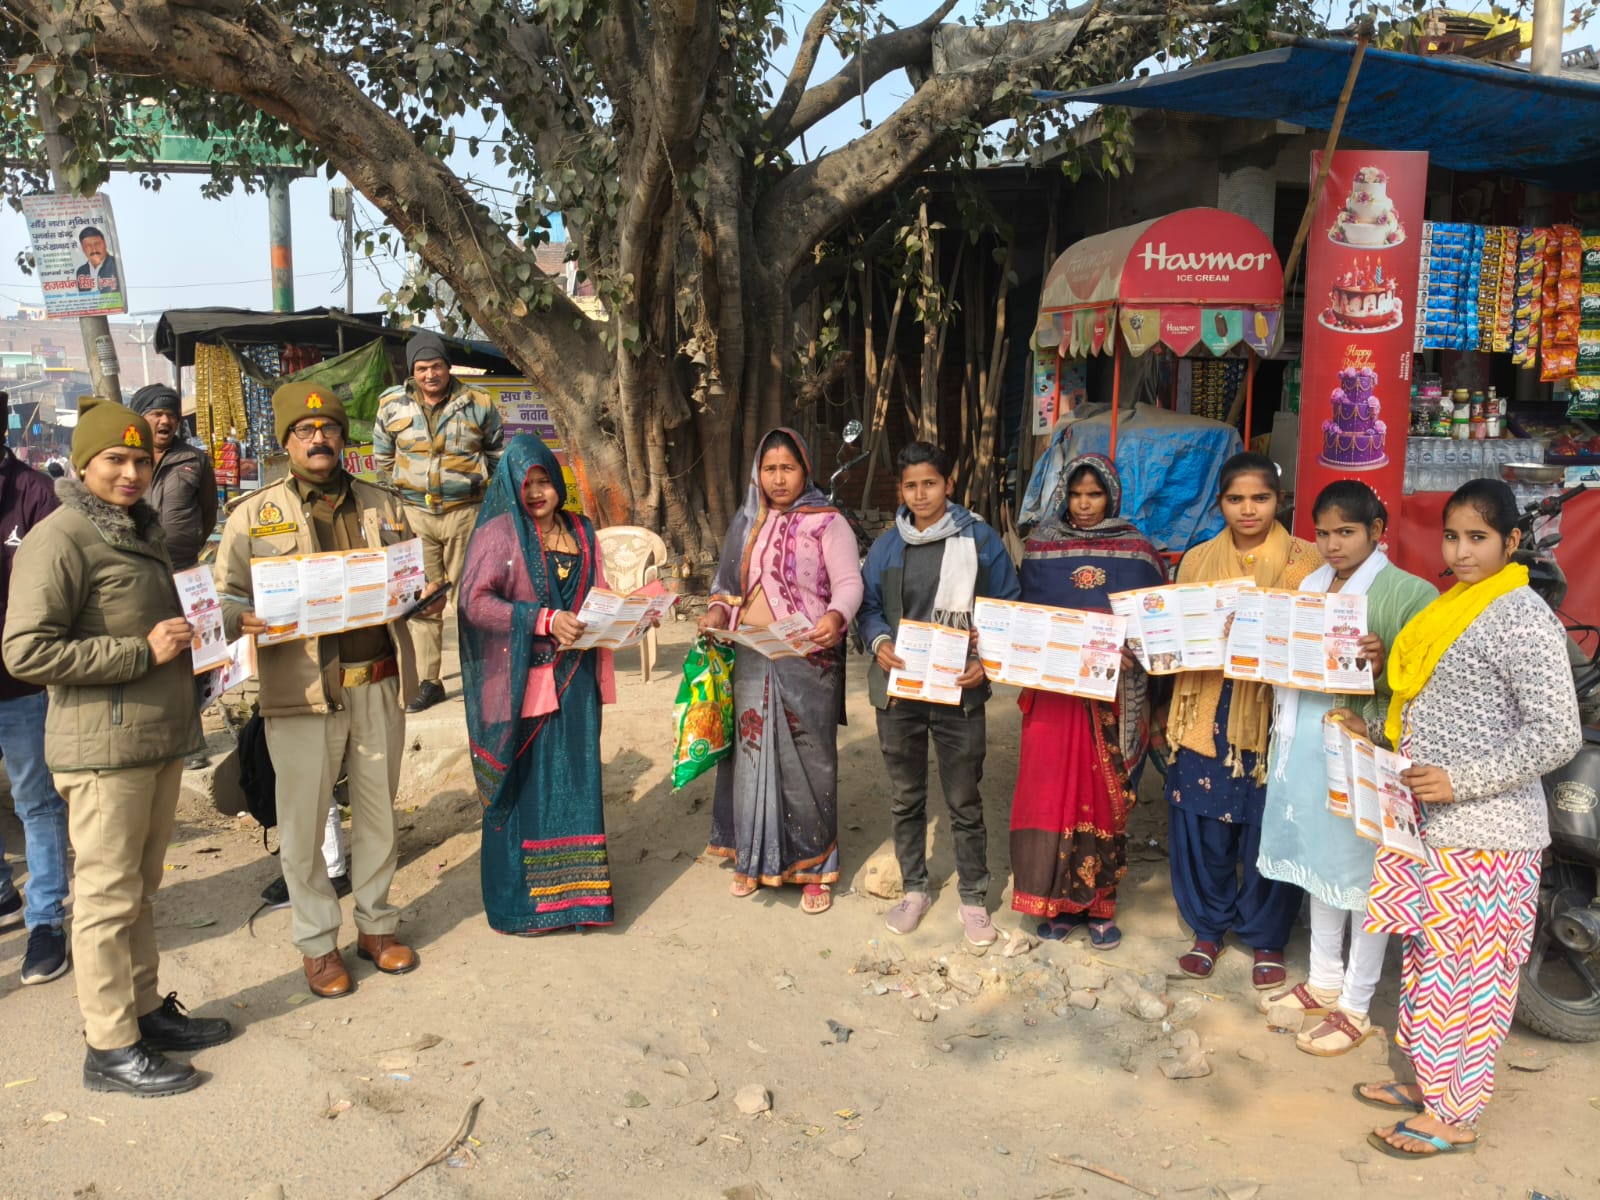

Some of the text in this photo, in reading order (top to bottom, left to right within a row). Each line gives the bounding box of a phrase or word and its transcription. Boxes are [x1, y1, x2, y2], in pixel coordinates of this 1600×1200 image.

[1137, 242, 1272, 272] Havmor
[1176, 274, 1230, 282] ICE CREAM
[1345, 344, 1373, 358] Happy
[1343, 357, 1376, 370] Birthday
[499, 391, 521, 402] सच
[522, 390, 532, 401] है
